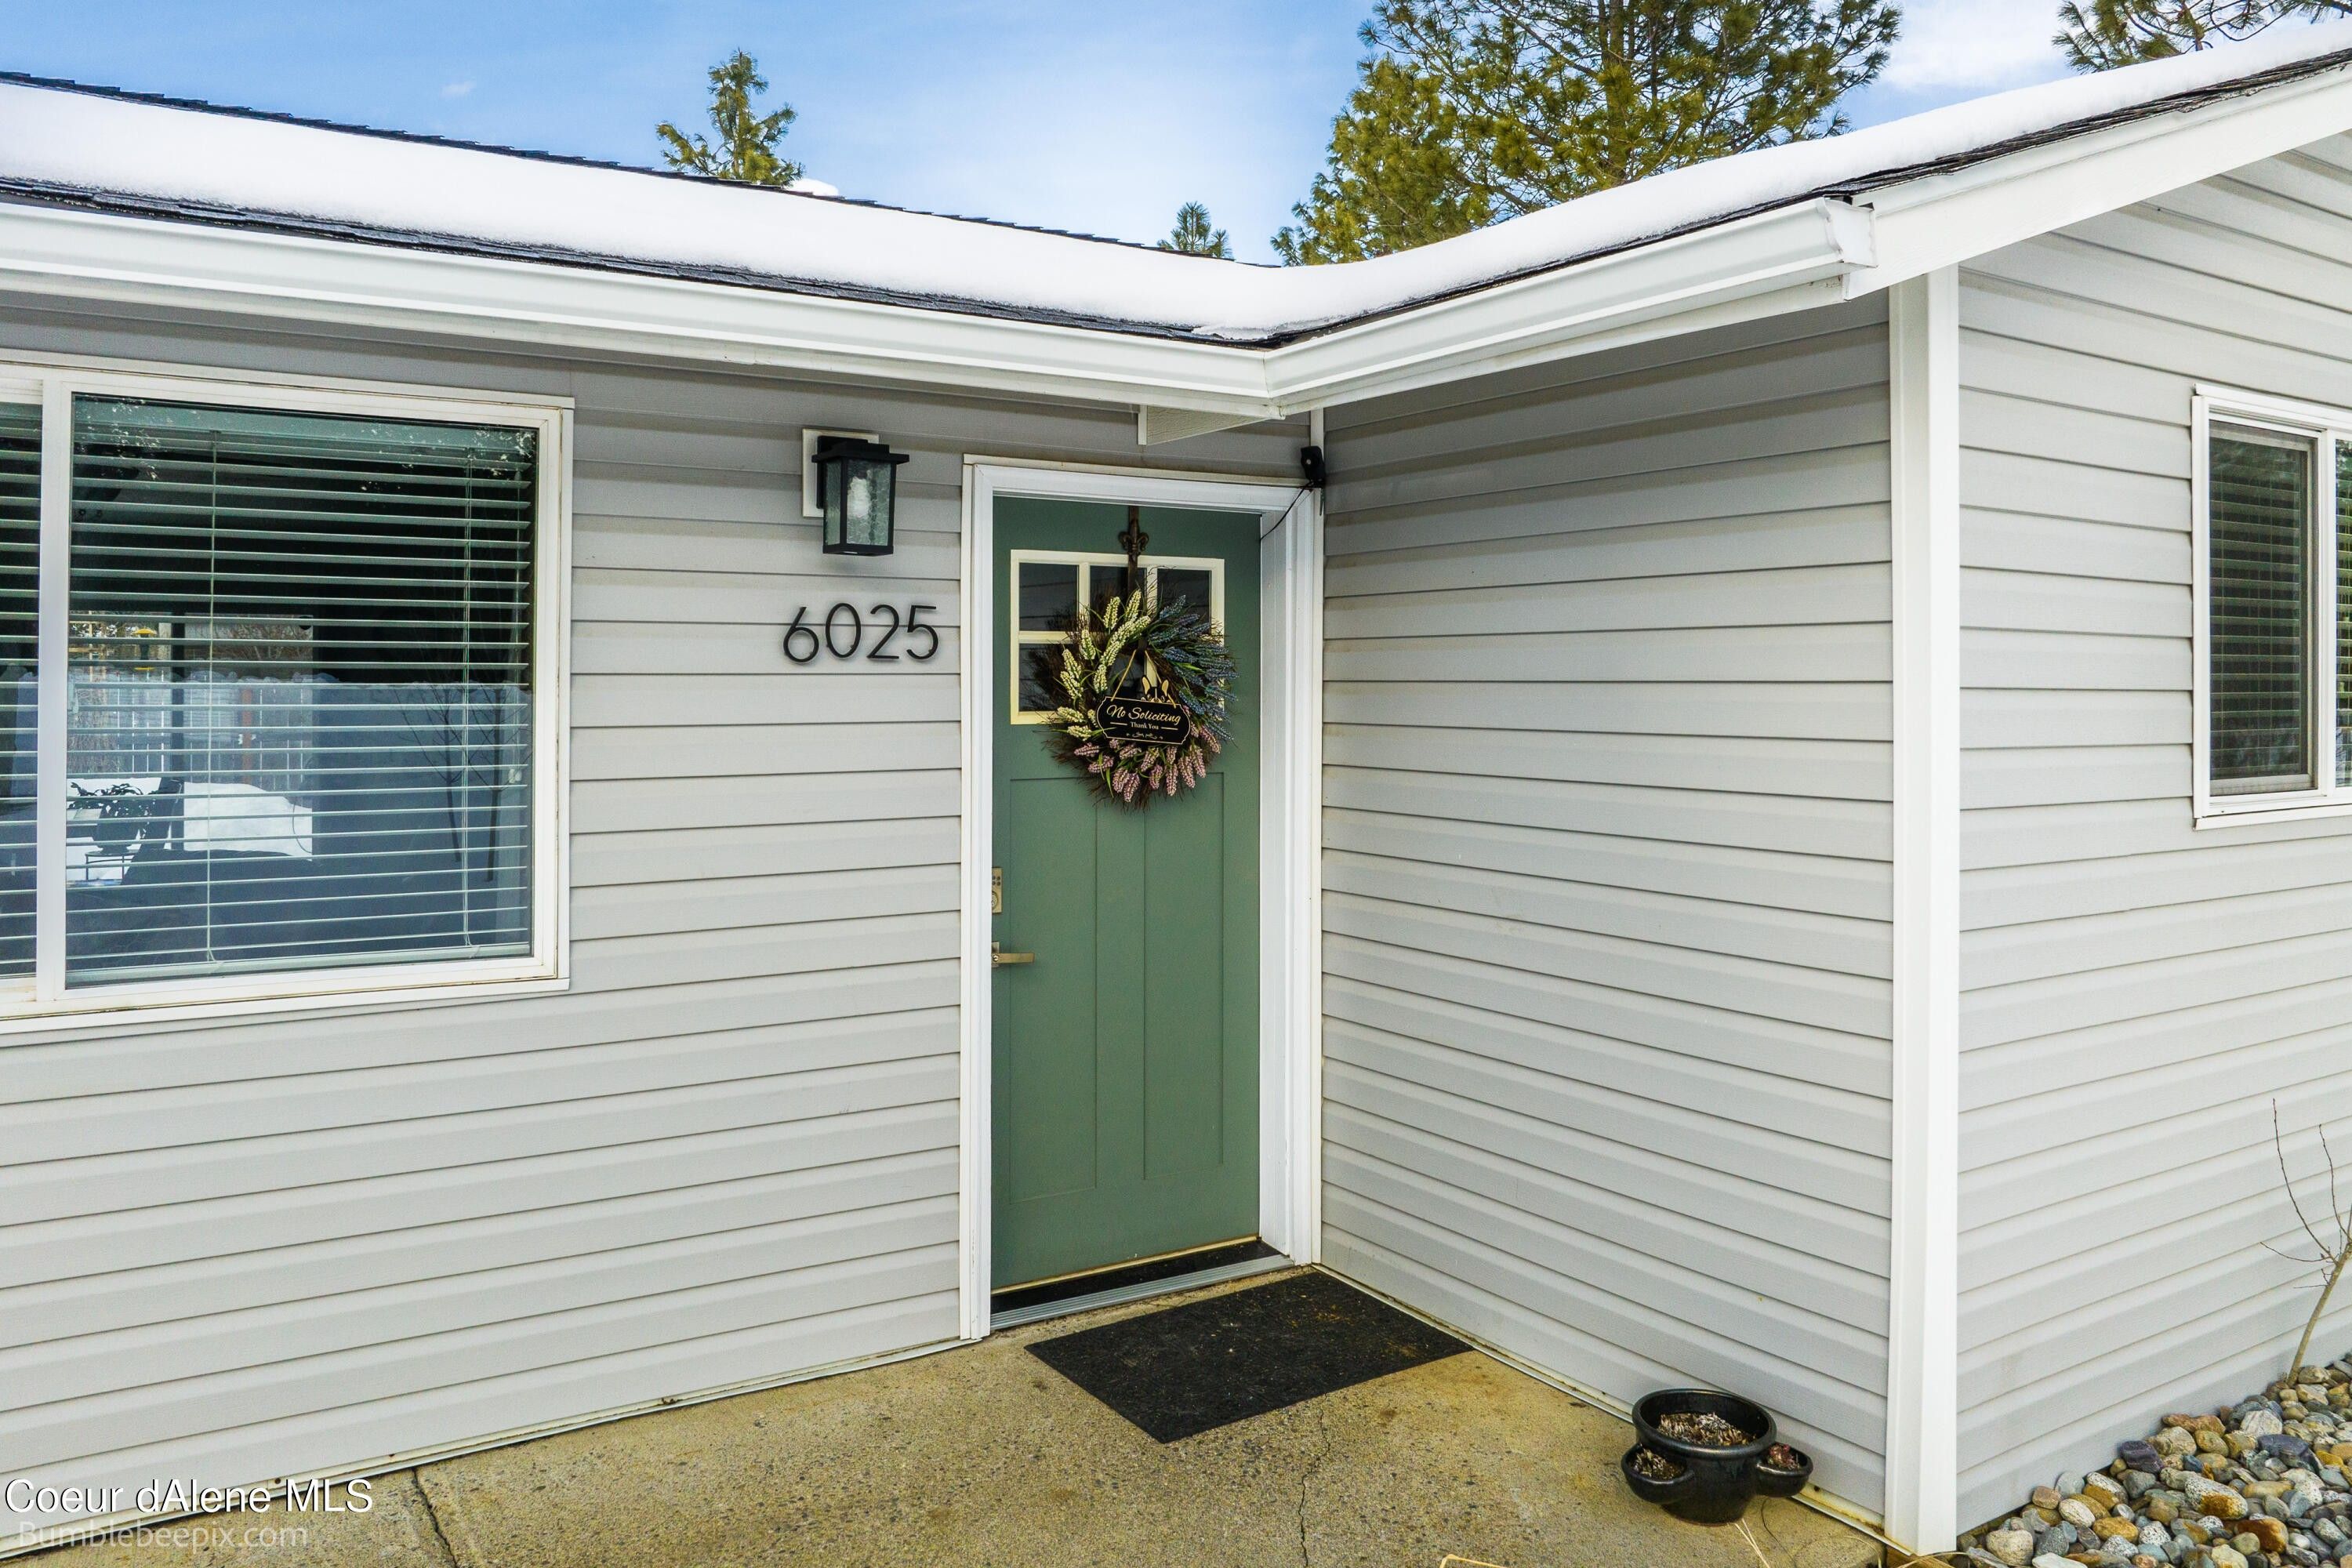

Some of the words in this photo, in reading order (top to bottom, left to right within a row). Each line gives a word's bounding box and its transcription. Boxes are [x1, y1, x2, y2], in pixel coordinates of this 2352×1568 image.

[783, 603, 939, 663] 6025
[1106, 705, 1126, 718] No
[1128, 707, 1181, 725] Soliciting
